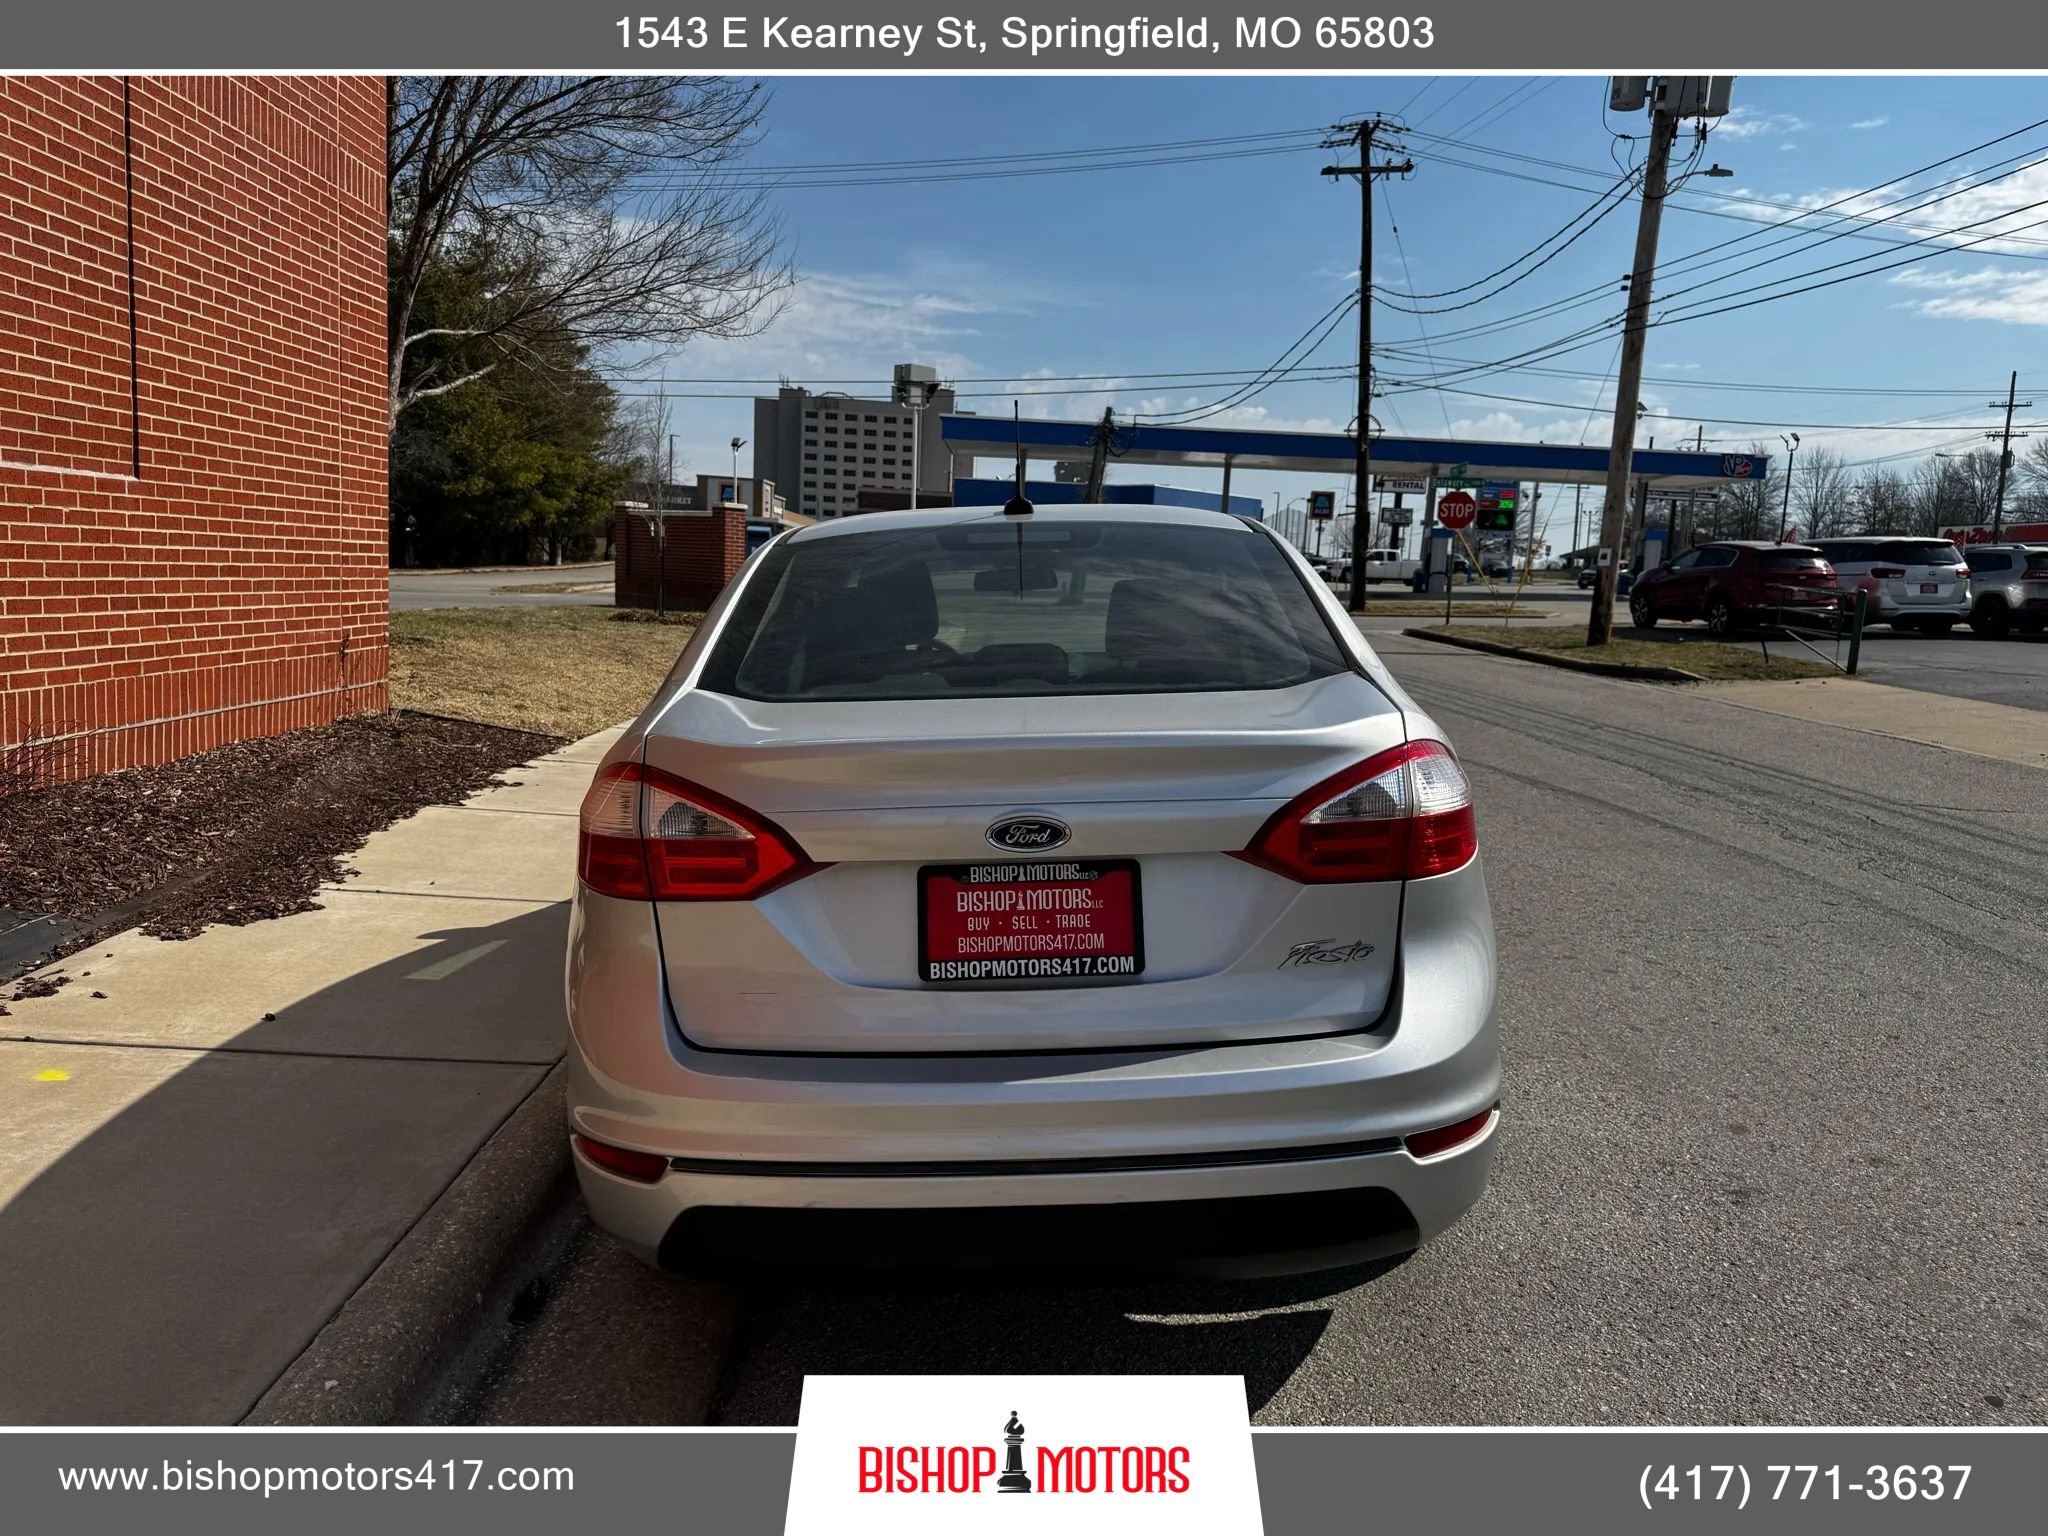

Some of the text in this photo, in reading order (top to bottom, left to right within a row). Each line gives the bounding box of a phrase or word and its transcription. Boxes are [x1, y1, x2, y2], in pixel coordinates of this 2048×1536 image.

[1392, 480, 1424, 489] RENTAL
[1440, 503, 1474, 518] STOP
[1005, 824, 1052, 844] Ford
[970, 865, 1018, 883] BISHOP
[1026, 864, 1080, 882] MOTORS
[957, 891, 1015, 912] BISHOP
[1027, 888, 1092, 910] MOTORS
[967, 914, 1091, 931] BUY SELL TRADE
[958, 933, 1105, 953] BISHOPMOTORS417.COM
[930, 956, 1135, 979] BISHOPMOTORS417.COM
